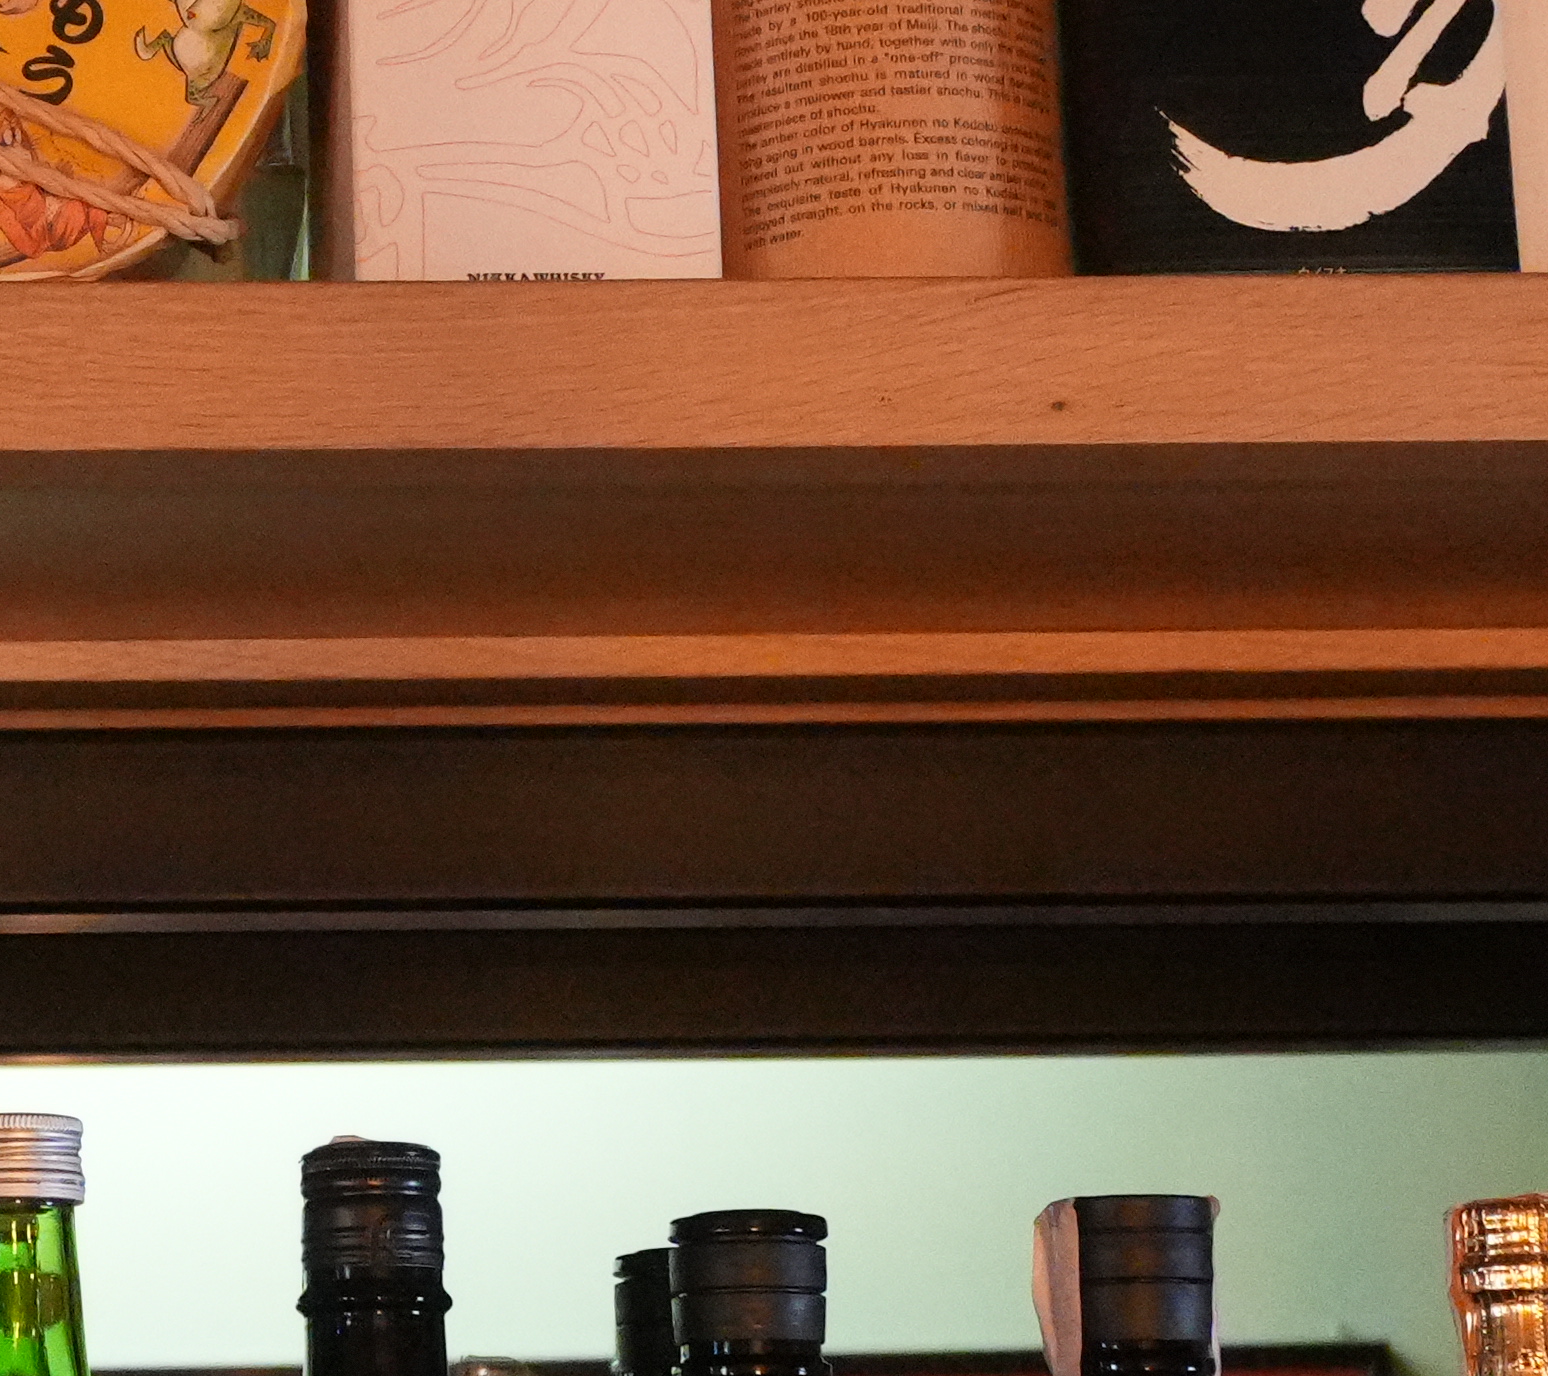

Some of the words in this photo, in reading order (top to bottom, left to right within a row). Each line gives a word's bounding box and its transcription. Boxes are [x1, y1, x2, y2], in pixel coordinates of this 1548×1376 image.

[896, 2, 965, 17] traditional
[947, 18, 969, 33] The
[814, 41, 832, 56] by
[878, 35, 936, 51] together
[940, 37, 968, 49] with
[794, 55, 848, 75] distilled
[818, 70, 869, 87] shochu
[893, 67, 951, 81] matured
[859, 86, 886, 100] and
[890, 85, 932, 97] tastier
[809, 108, 823, 121] of
[802, 123, 837, 140] color
[840, 119, 855, 133] of
[859, 116, 928, 132] Hyakunen
[931, 118, 950, 130] no
[802, 143, 814, 156] in
[816, 137, 855, 153] wood
[913, 130, 958, 145] Excess
[783, 161, 805, 177] out
[810, 152, 863, 170] without
[869, 150, 895, 165] any
[901, 147, 929, 162] loss
[936, 149, 950, 162] in
[804, 168, 855, 185] natural,
[857, 165, 927, 182] refreshing
[929, 165, 955, 180] and
[957, 167, 987, 181] clear
[828, 184, 862, 201] taste
[867, 183, 884, 197] of
[889, 181, 957, 197] Hyakunen
[963, 184, 980, 197] no
[847, 202, 866, 215] on
[870, 198, 894, 213] the
[898, 197, 939, 212] rocks,
[943, 199, 958, 211] or
